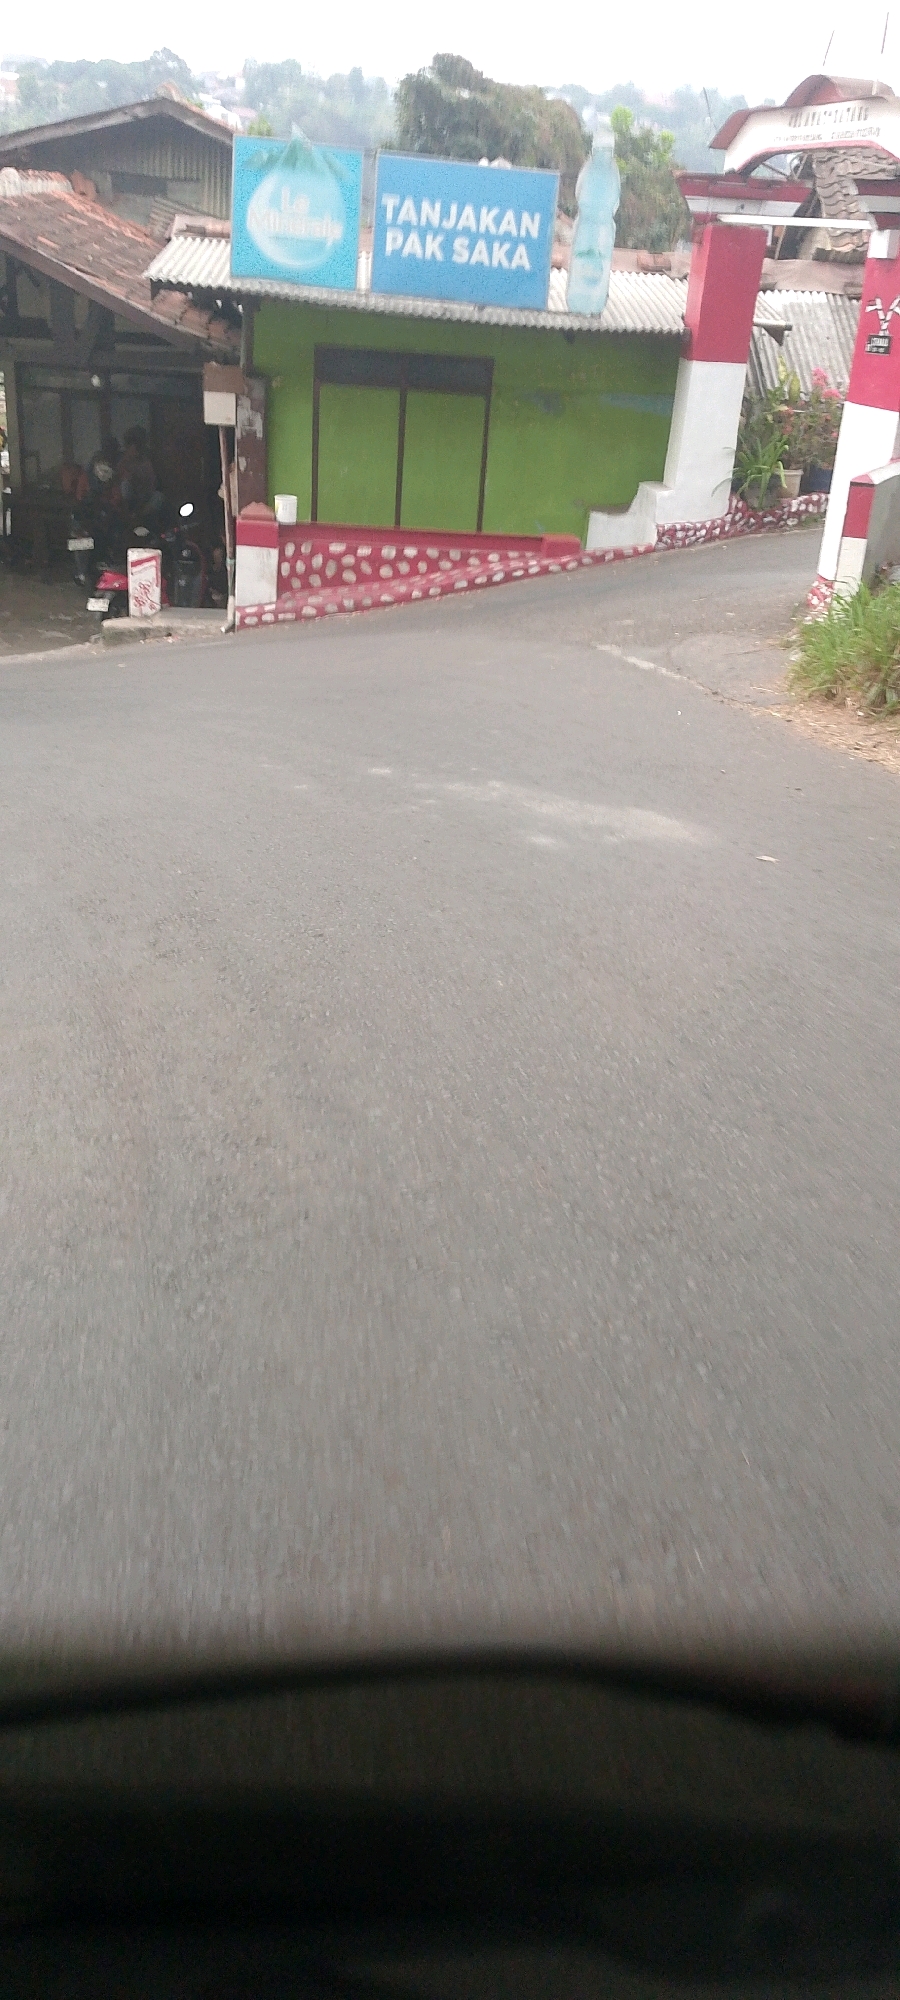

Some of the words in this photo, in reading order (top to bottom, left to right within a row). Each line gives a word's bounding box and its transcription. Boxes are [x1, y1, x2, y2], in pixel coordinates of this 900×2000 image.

[382, 193, 541, 239] TANJAKAN
[385, 227, 444, 262] PAK
[453, 236, 532, 271] SAKA
